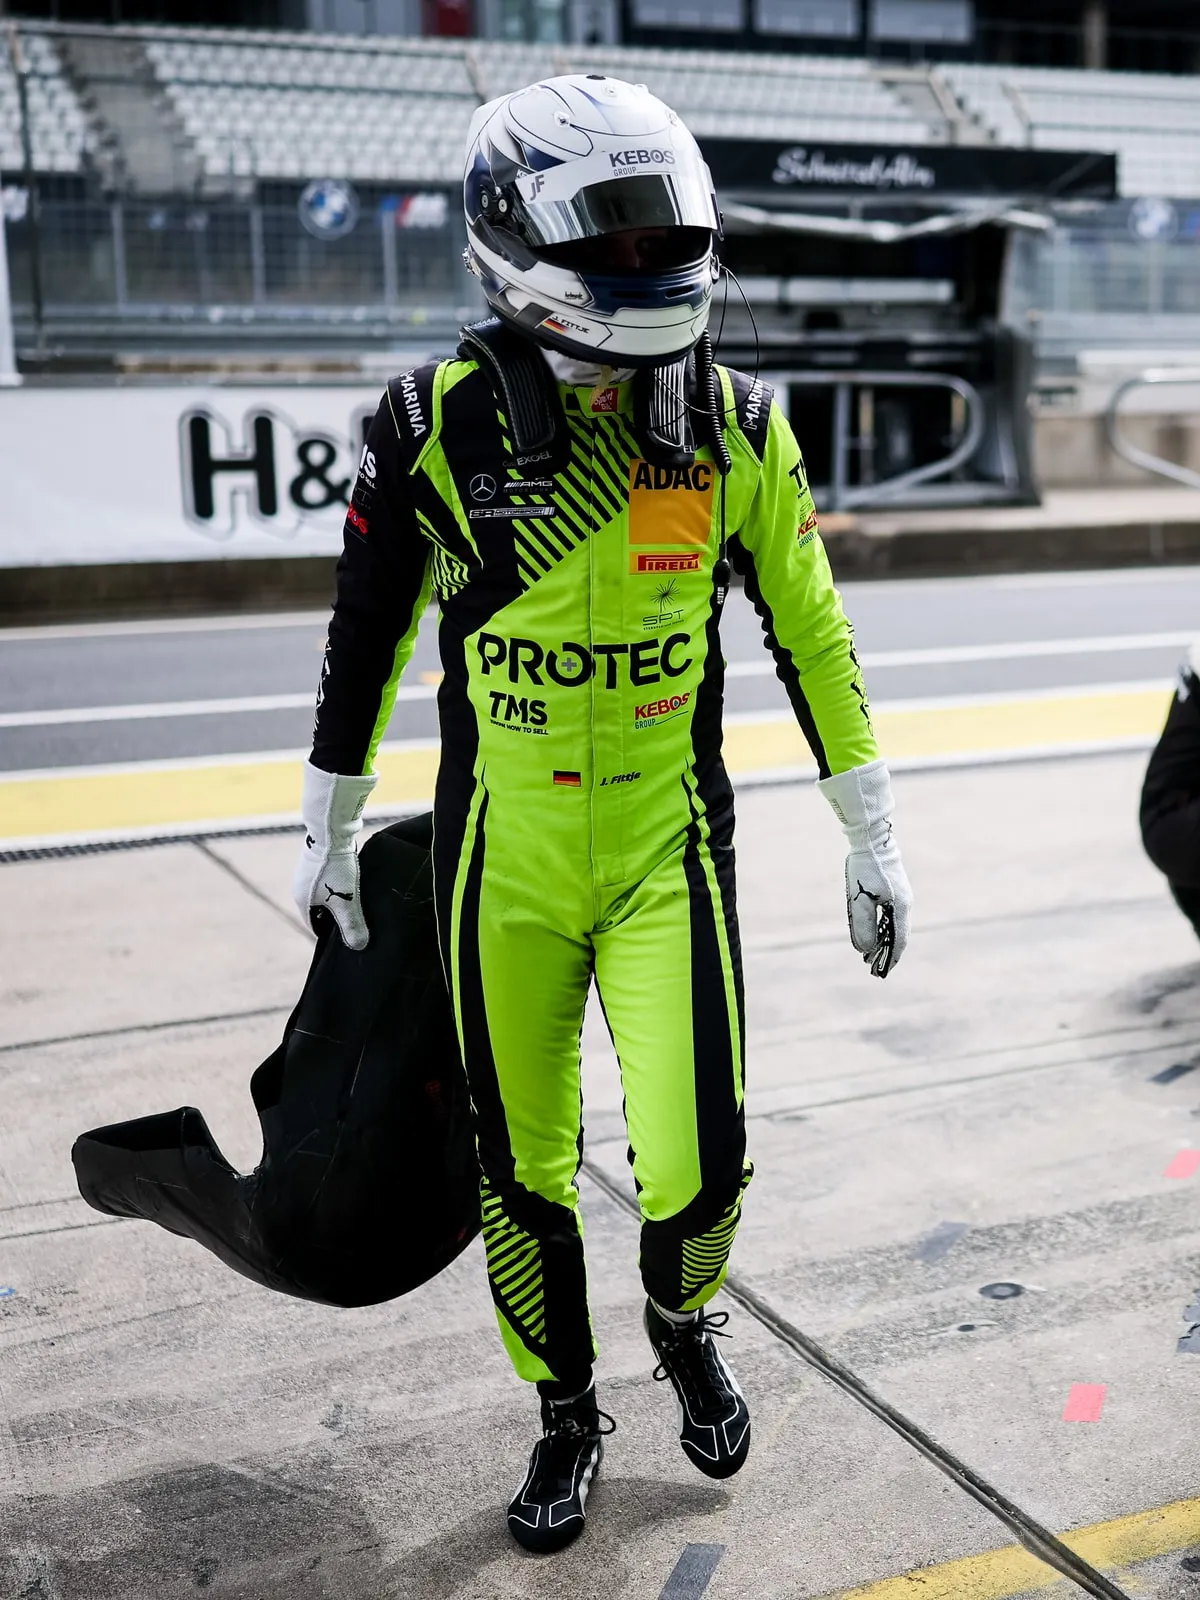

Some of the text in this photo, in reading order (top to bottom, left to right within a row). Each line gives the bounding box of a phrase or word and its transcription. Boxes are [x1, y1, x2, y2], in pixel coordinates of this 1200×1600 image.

[609, 149, 676, 168] KEBOS
[613, 166, 637, 177] GROUP
[184, 408, 377, 526] H&
[633, 463, 711, 492] ADAC
[637, 553, 699, 571] PIRELLI
[642, 609, 684, 626] SPT
[477, 631, 693, 690] PROTEC
[489, 690, 548, 726] TMS
[634, 692, 691, 720] KEBOS
[522, 726, 532, 734] TO
[533, 728, 549, 736] SELL
[634, 718, 656, 730] GROUP
[600, 771, 641, 787] J. Fittje
